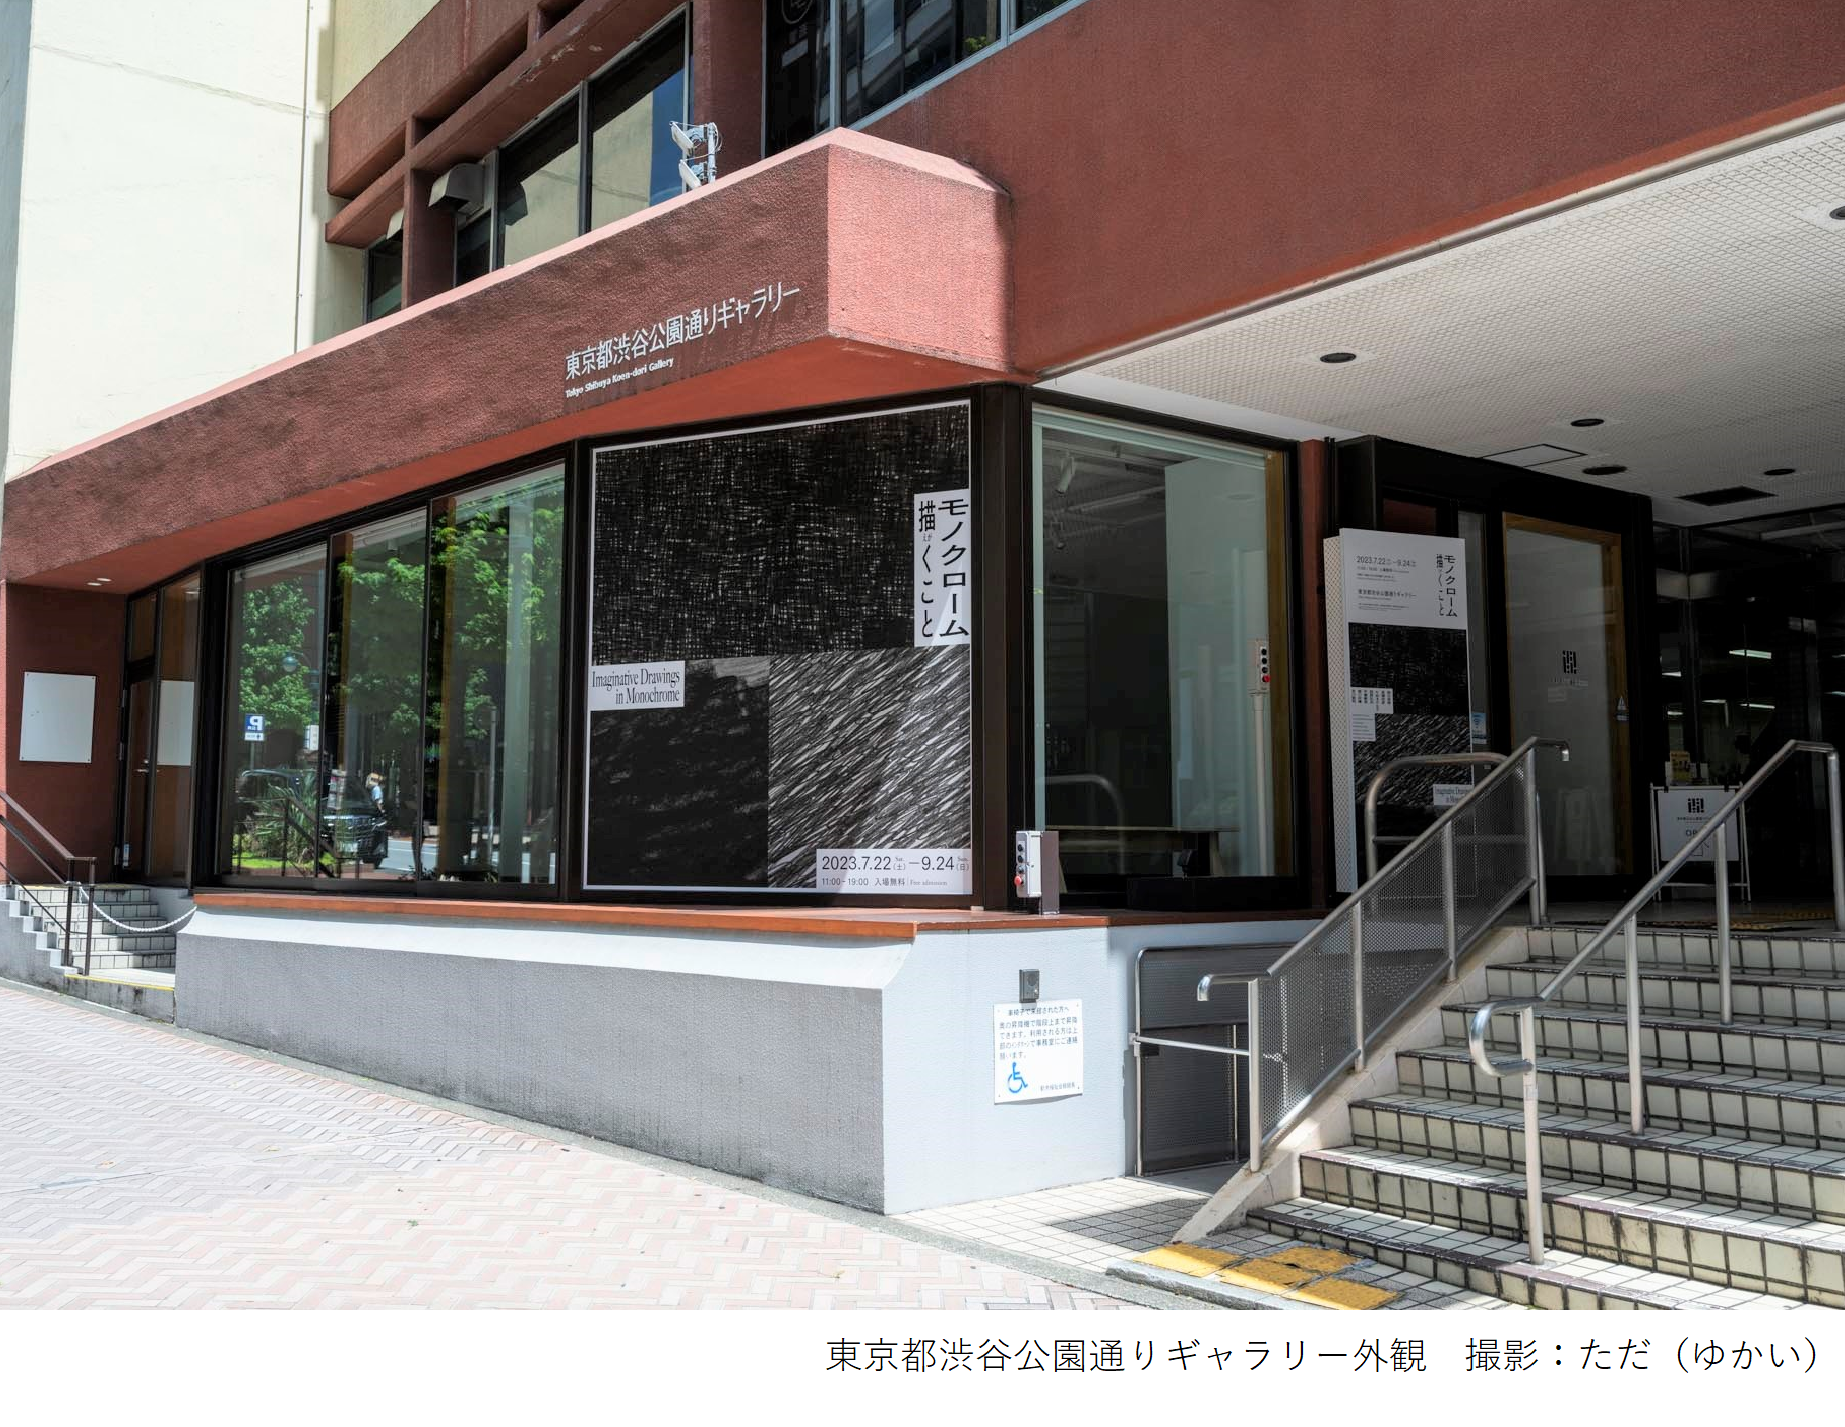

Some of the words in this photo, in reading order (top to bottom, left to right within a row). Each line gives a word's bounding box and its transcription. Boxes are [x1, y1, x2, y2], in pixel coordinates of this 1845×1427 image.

[565, 281, 800, 380] 東京都渋谷公園通りギャラリー
[565, 387, 584, 398] Tokyo
[585, 378, 611, 393] Shibuya
[612, 364, 647, 383] Koen-dori
[648, 357, 674, 372] Gallery
[938, 499, 970, 637] モノクローム
[1443, 555, 1457, 617] モノクローム
[592, 670, 639, 692] Imaginative
[640, 667, 680, 688] Drawings
[616, 689, 624, 704] in
[626, 686, 680, 704] Monochrome
[822, 856, 892, 870] 2023.7.22
[874, 877, 905, 886] 入場無料
